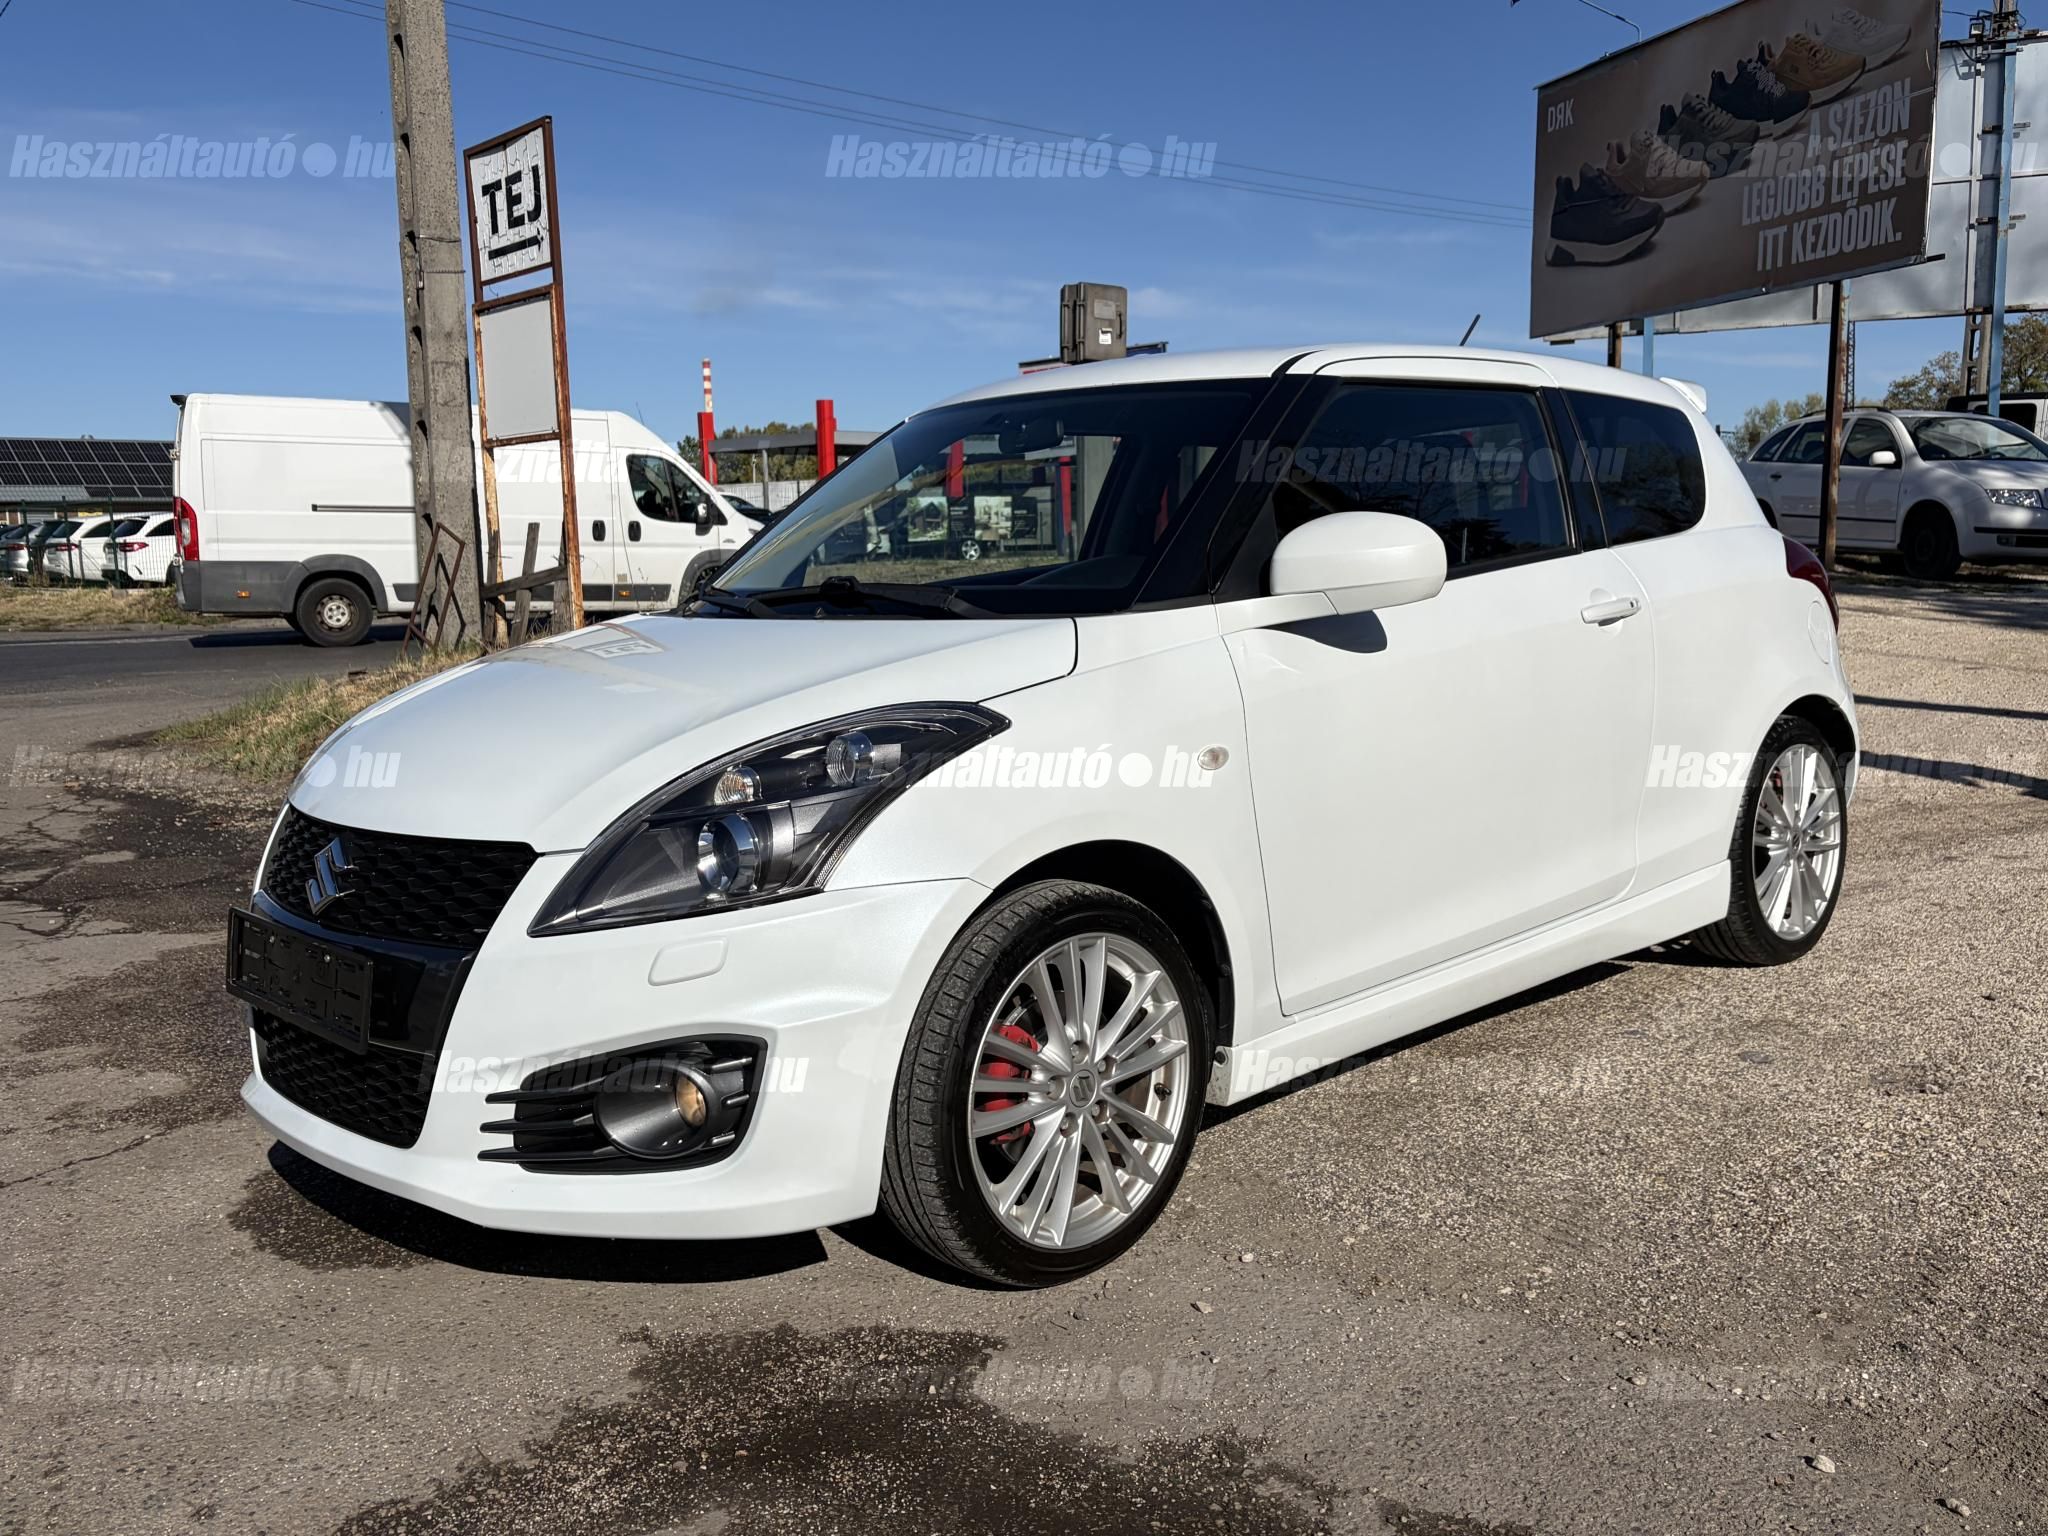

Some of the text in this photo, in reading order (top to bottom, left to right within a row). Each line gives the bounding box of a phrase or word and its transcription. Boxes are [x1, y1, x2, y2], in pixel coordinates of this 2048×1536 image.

[1808, 77, 1912, 158] A SZEZON
[482, 164, 542, 236] TEJ
[1742, 138, 1909, 226] LEGJOBB LÉPÉSE
[1757, 225, 1788, 271] ITT
